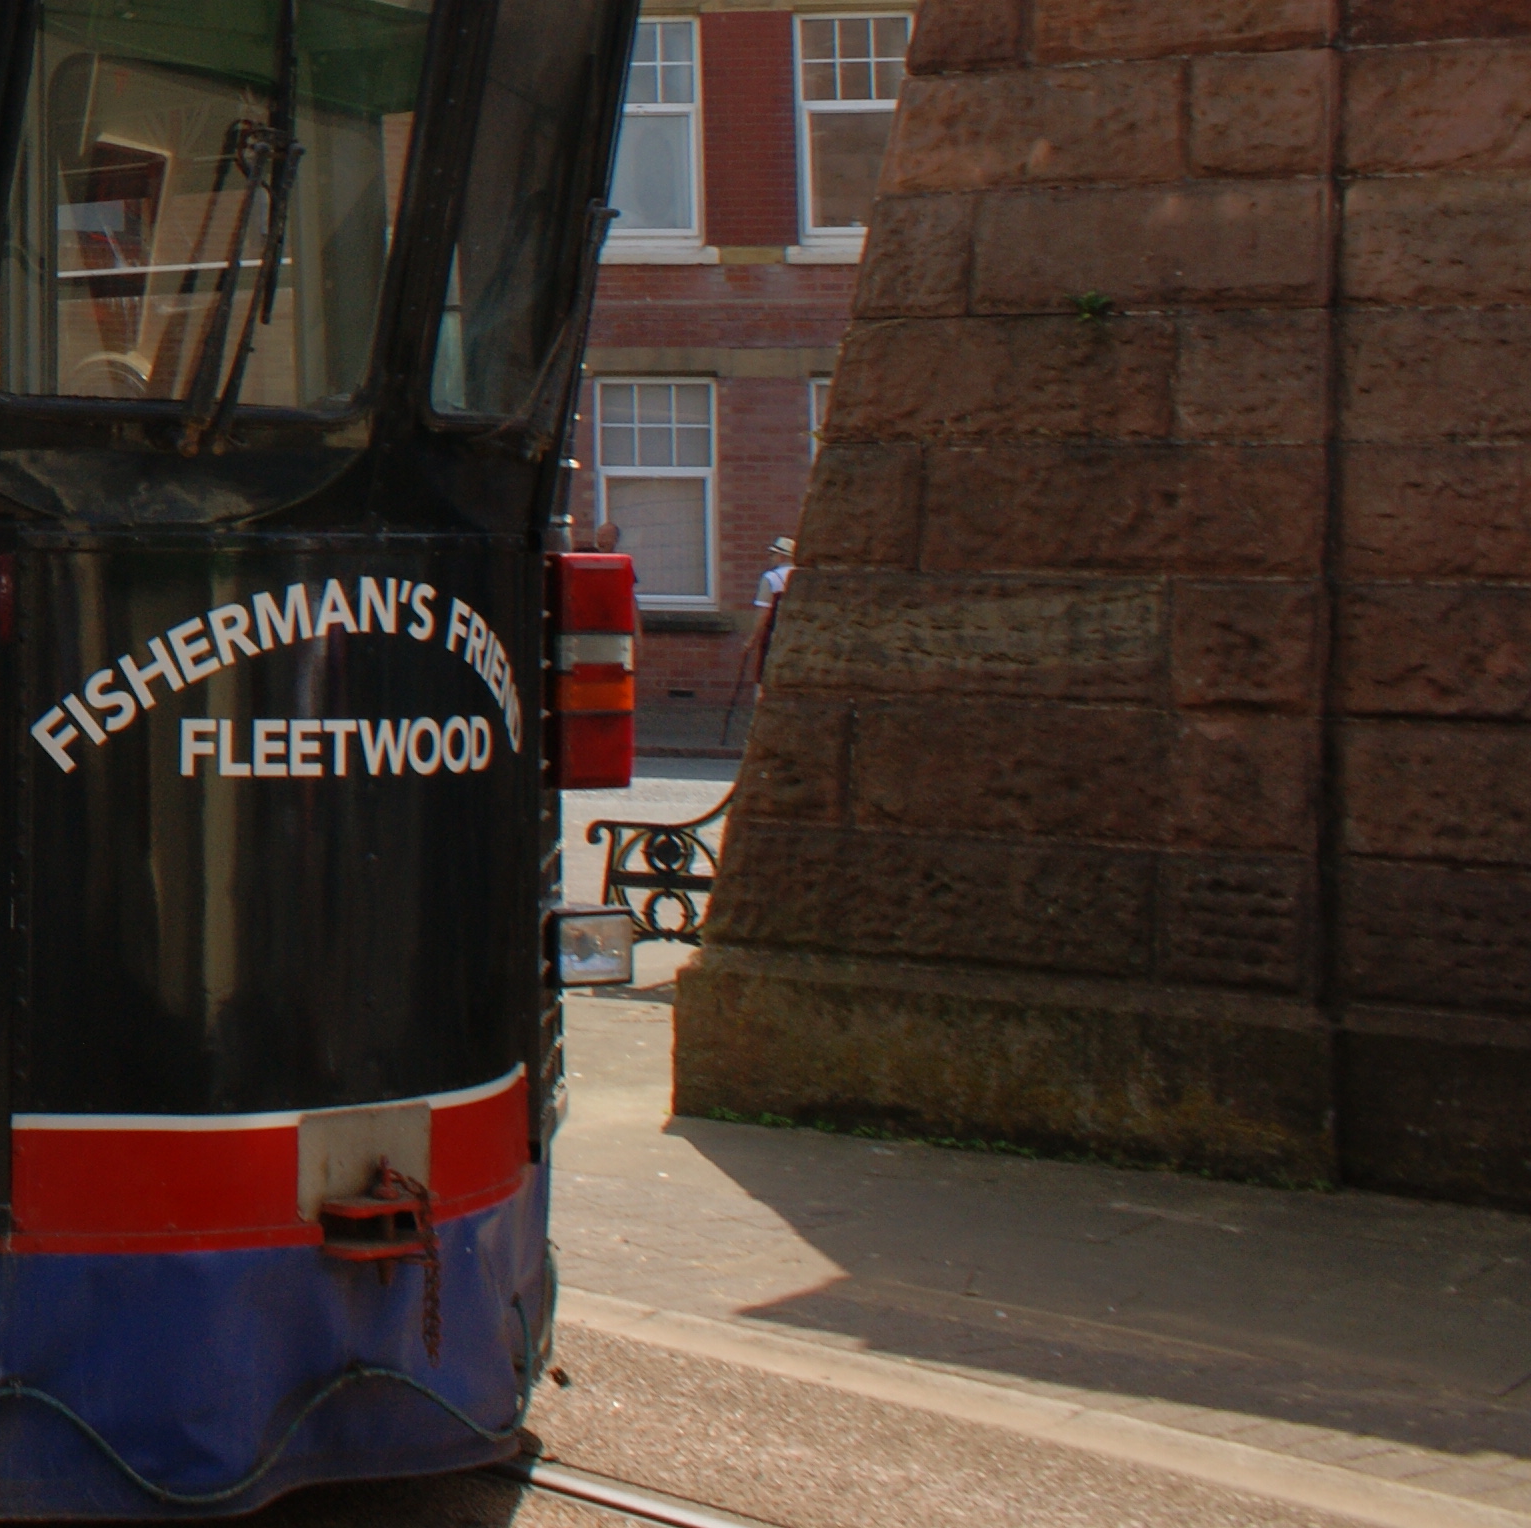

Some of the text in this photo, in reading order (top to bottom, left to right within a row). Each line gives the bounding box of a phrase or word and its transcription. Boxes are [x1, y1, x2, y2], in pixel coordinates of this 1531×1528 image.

[30, 575, 523, 773] FISHERMAN'S FRIEND
[179, 715, 492, 776] FLEETWOOD
